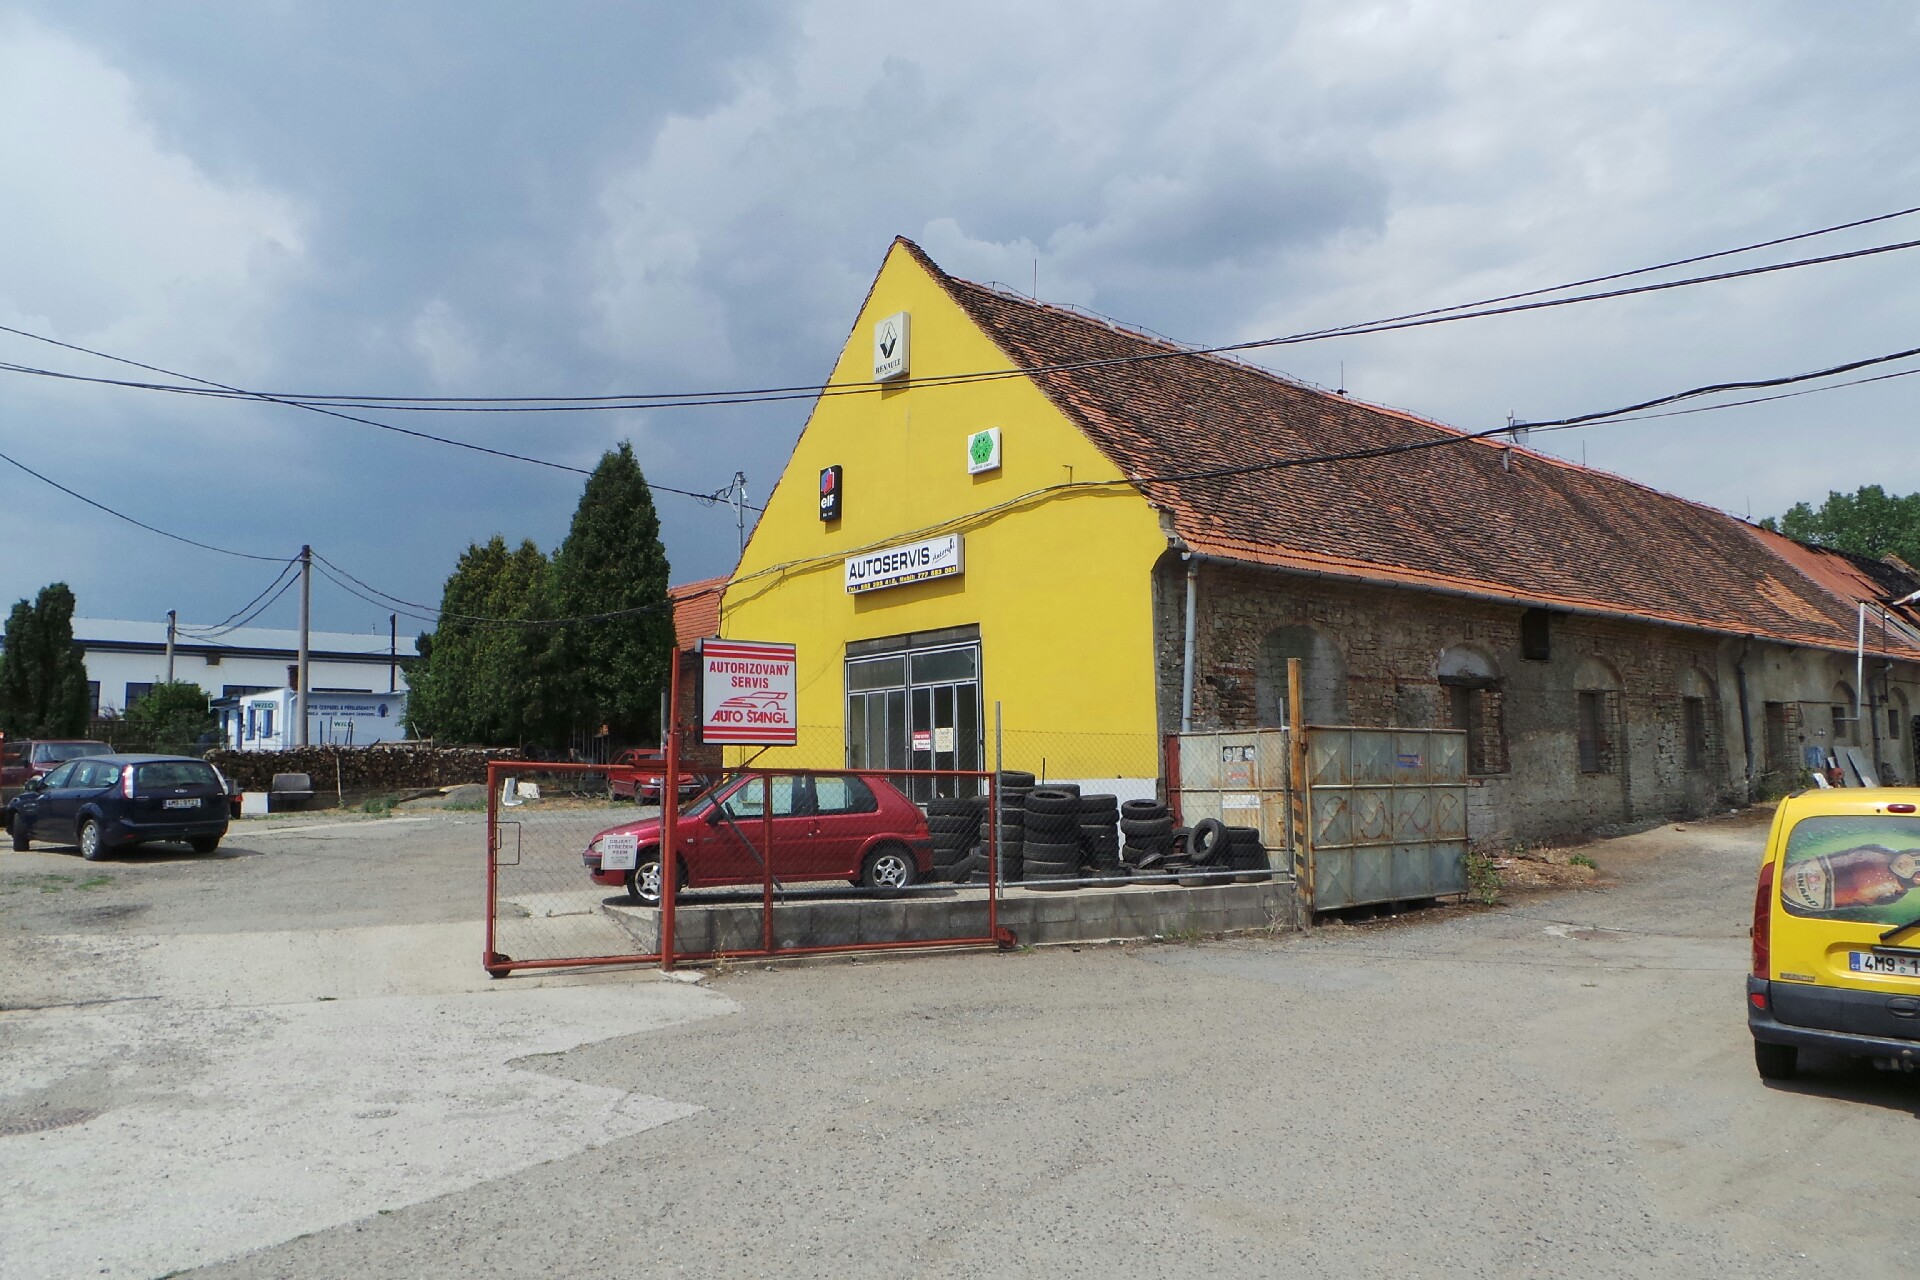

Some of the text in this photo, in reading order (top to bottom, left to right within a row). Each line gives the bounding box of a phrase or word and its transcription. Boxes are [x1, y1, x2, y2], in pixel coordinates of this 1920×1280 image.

[875, 358, 901, 374] RENAULT
[821, 494, 835, 509] elf
[849, 546, 930, 580] AUTOSERVIS
[917, 571, 929, 579] 777
[709, 661, 790, 676] AUTORIZOVANÝ
[731, 676, 769, 689] SERVIS
[710, 709, 789, 724] AUTO ŠTANGL
[1865, 956, 1895, 972] 4M9
